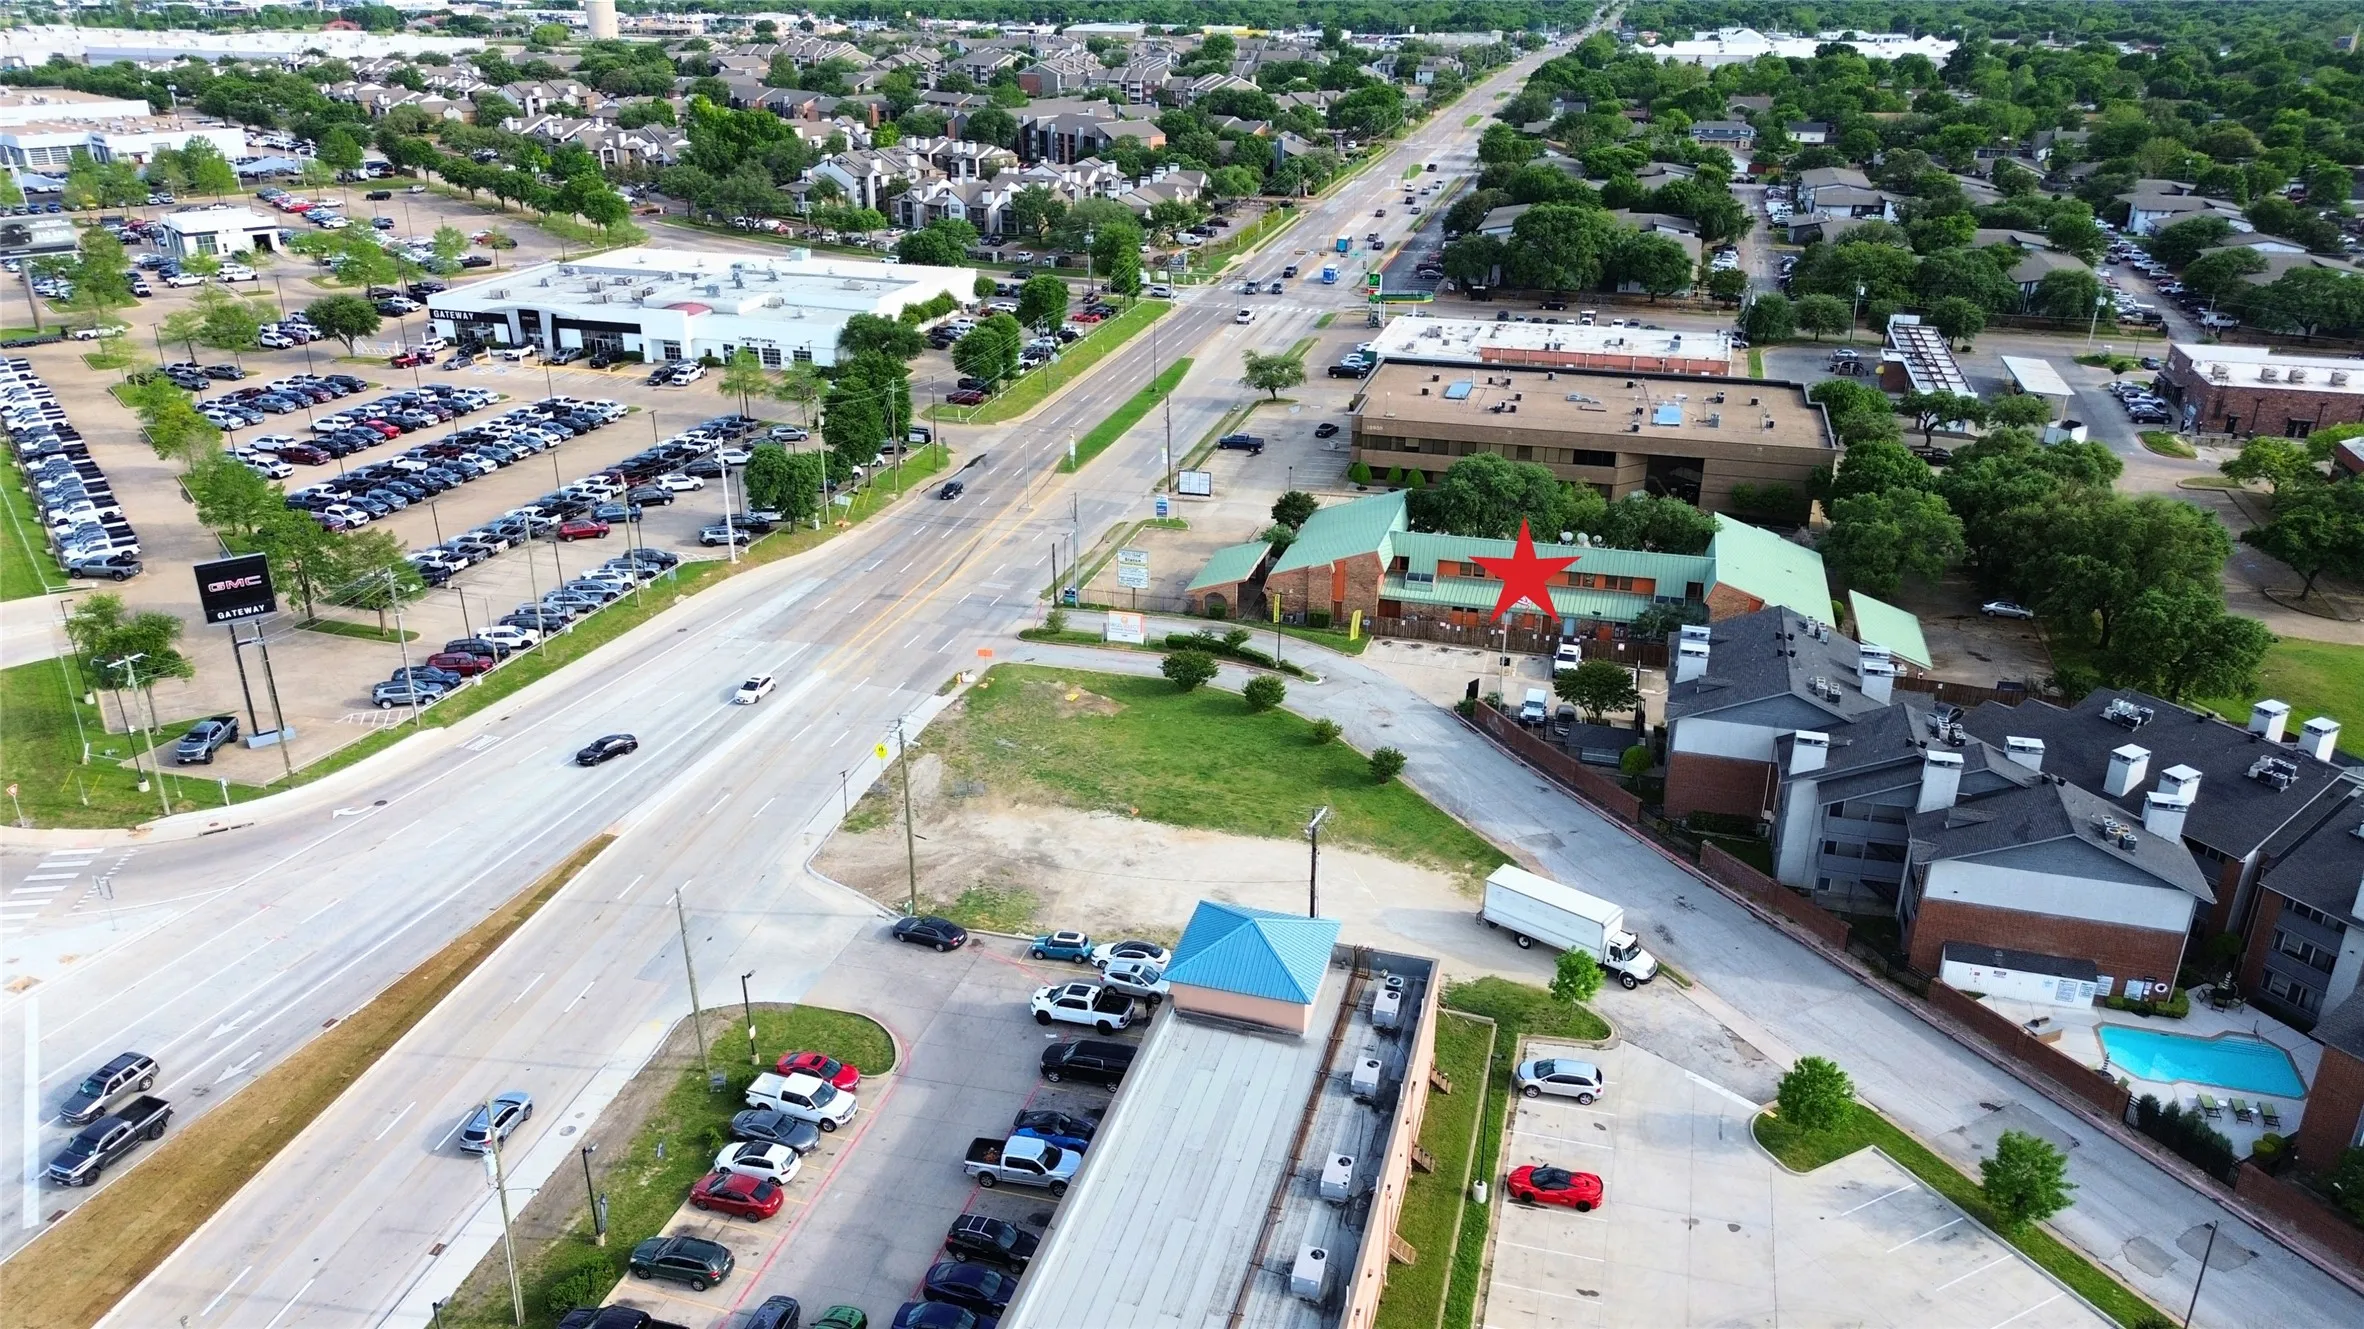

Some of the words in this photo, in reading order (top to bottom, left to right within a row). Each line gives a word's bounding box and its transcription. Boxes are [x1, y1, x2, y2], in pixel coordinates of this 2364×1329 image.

[433, 310, 474, 320] GATEWAY
[208, 575, 262, 592] GMC
[217, 604, 265, 619] GATEWAY
